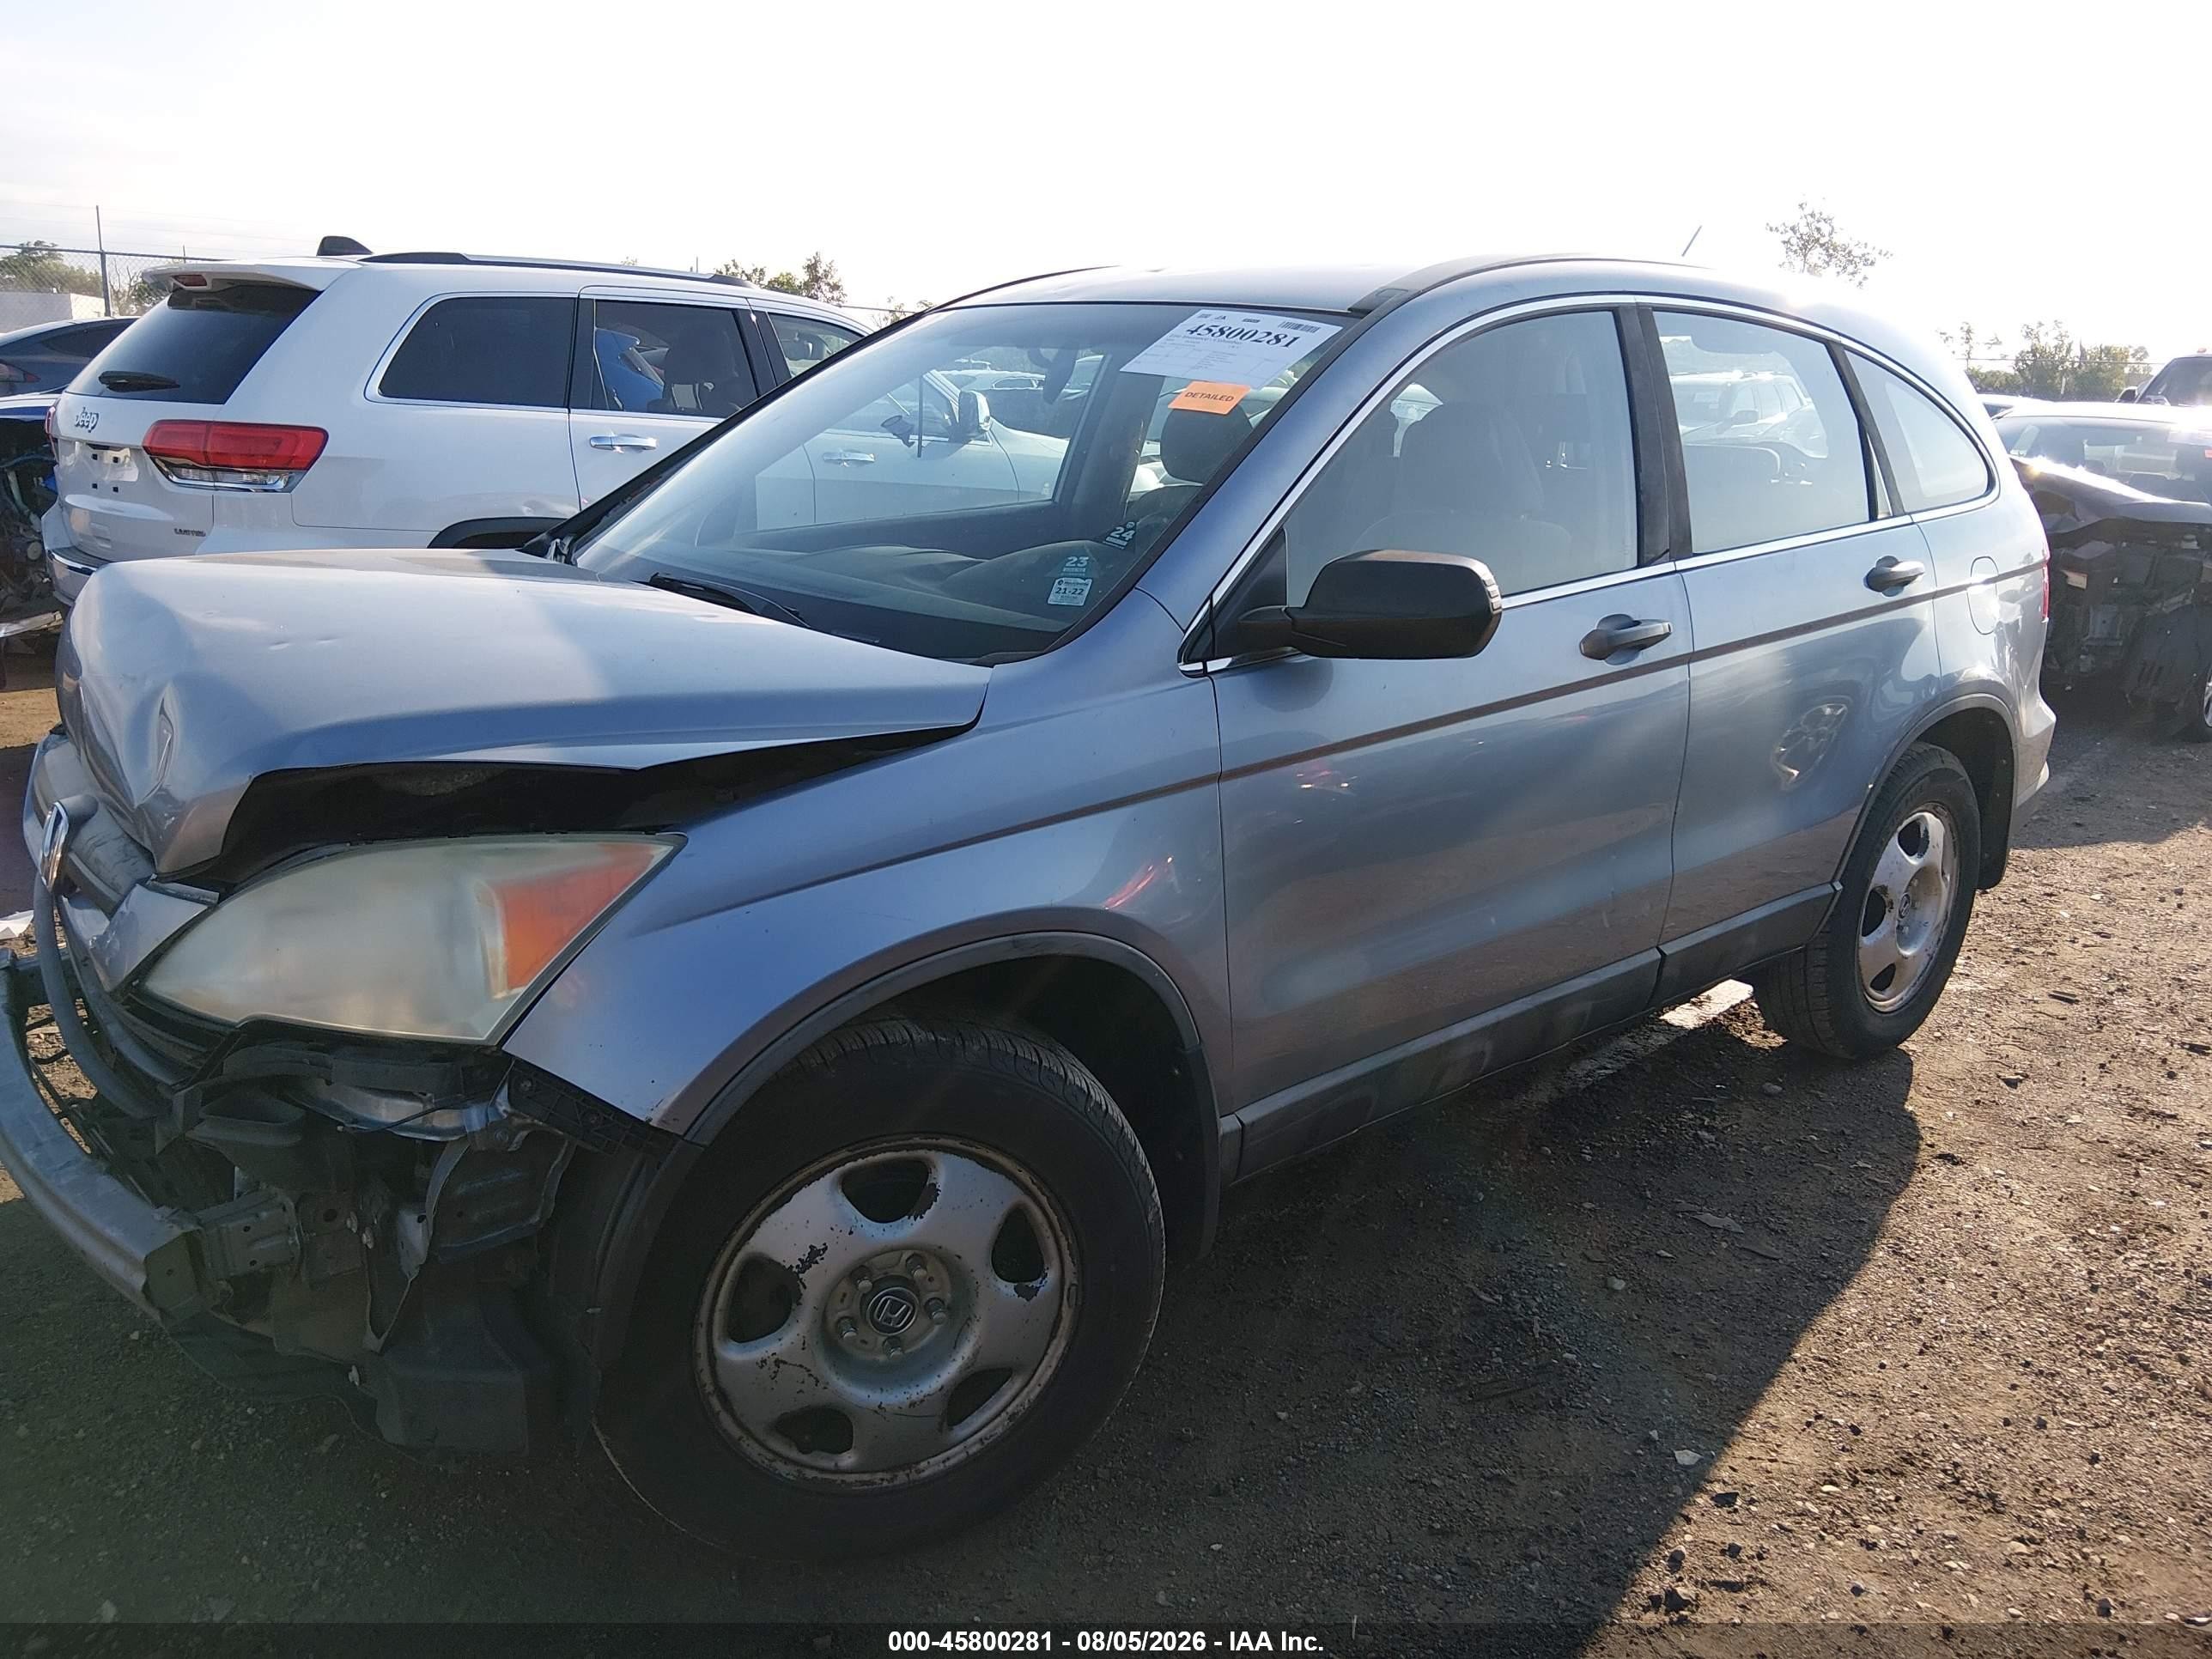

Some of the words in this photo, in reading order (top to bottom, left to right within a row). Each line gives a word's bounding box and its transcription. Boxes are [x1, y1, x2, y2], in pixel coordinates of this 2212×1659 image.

[1187, 323, 1301, 348] 45800281
[1184, 392, 1235, 402] DETAILED
[75, 406, 100, 433] Jeep
[1110, 526, 1135, 541] 24
[1065, 556, 1090, 567] 23
[1054, 586, 1085, 595] 21-22
